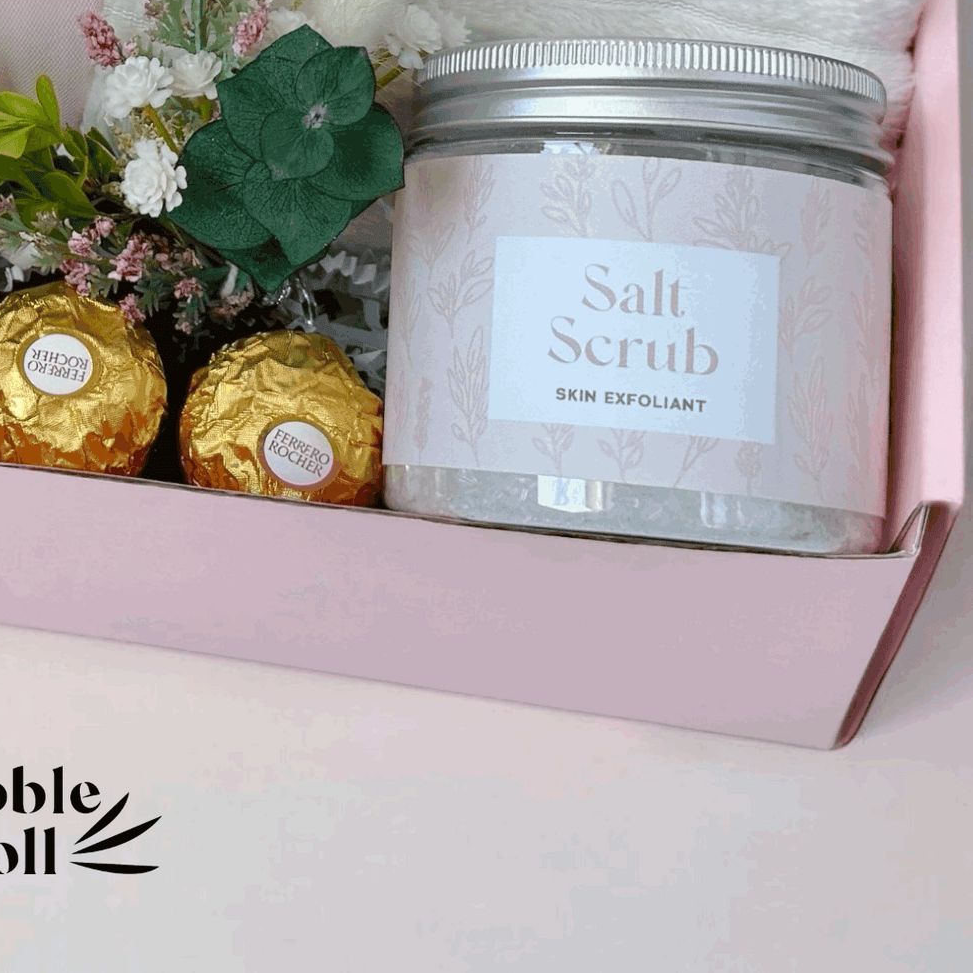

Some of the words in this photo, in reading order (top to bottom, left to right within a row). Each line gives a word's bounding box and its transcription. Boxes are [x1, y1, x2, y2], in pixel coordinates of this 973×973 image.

[581, 263, 693, 318] Salt
[32, 348, 89, 370] ROCHER
[547, 315, 719, 375] Scrub
[27, 360, 86, 383] FERRERO
[555, 387, 597, 403] SKIN
[604, 391, 707, 412] EXFOLIANT
[268, 440, 324, 477] ROCHER
[274, 428, 330, 465] FERRERO
